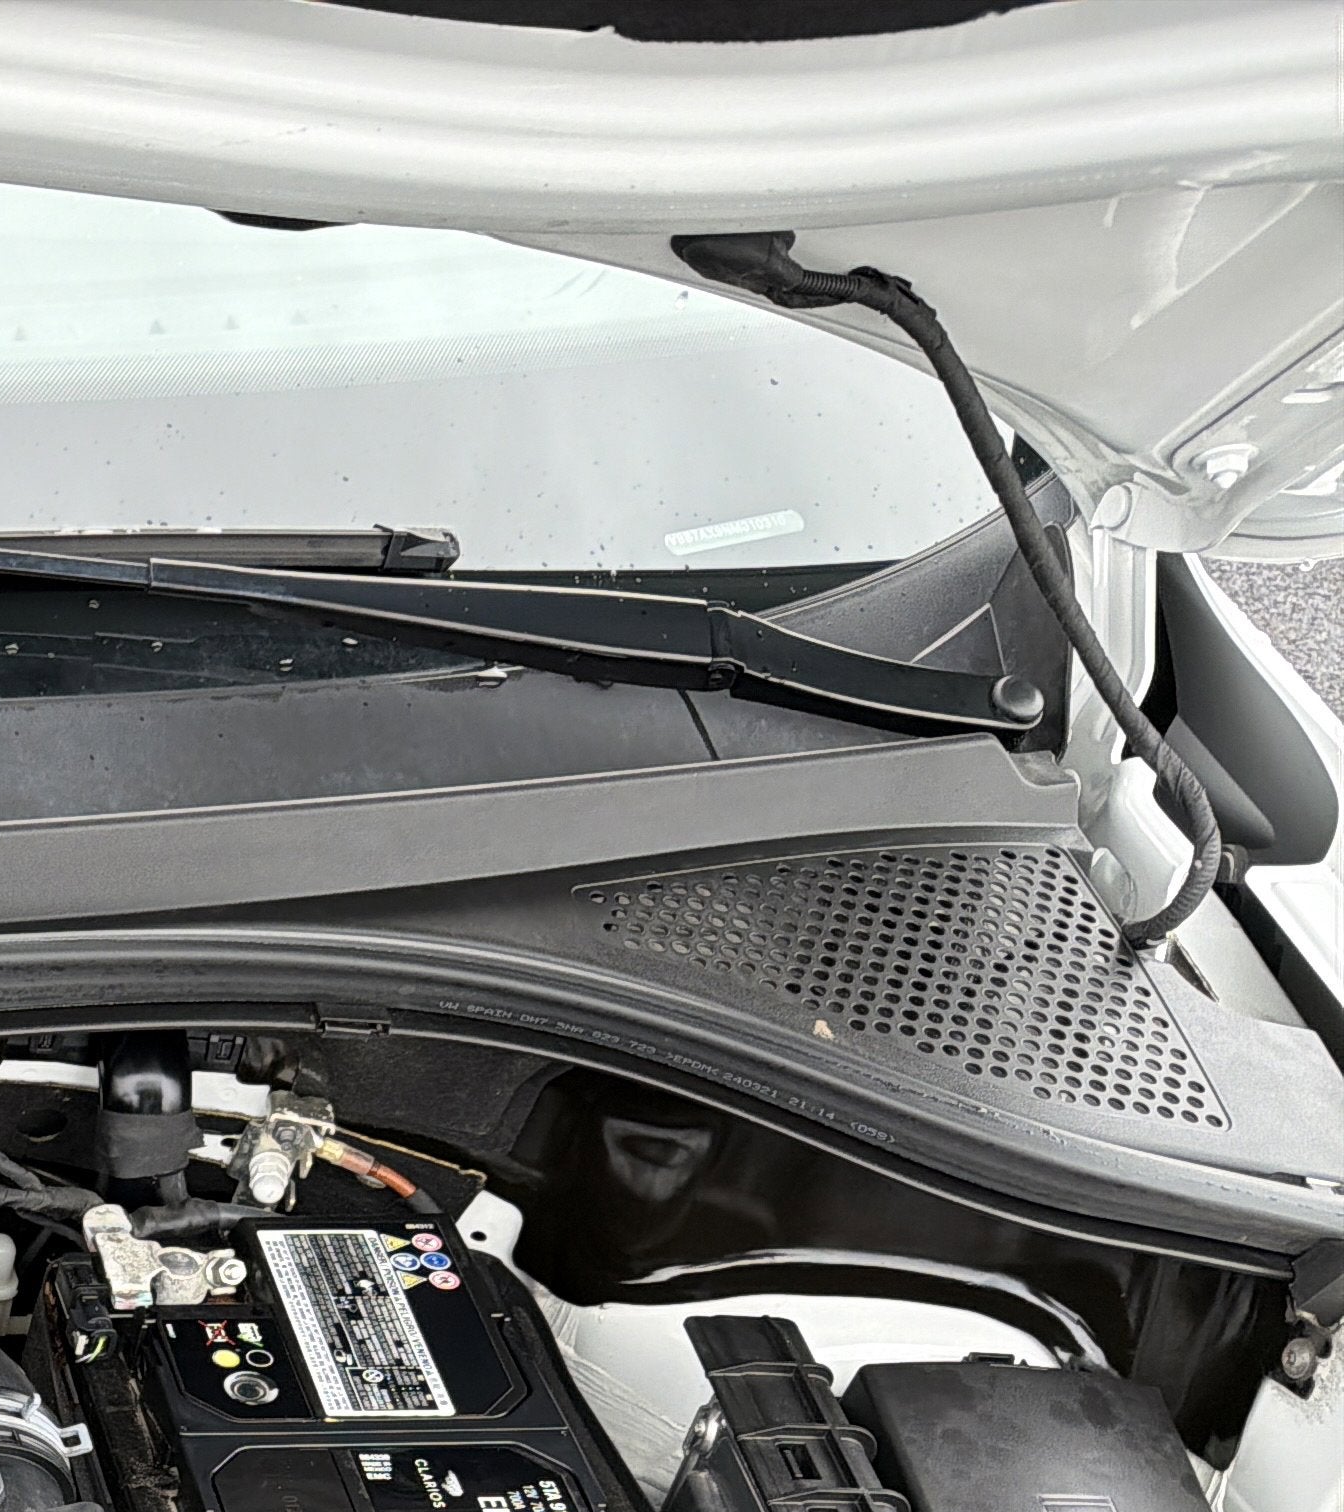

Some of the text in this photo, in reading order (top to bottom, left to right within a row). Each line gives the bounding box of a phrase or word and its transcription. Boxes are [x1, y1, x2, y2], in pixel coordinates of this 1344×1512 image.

[467, 1004, 512, 1019] SPAIN
[723, 1071, 779, 1098] 240321
[414, 1458, 446, 1510] CLARIOS
[522, 1485, 539, 1499] 12V
[538, 1480, 562, 1502] 5TA
